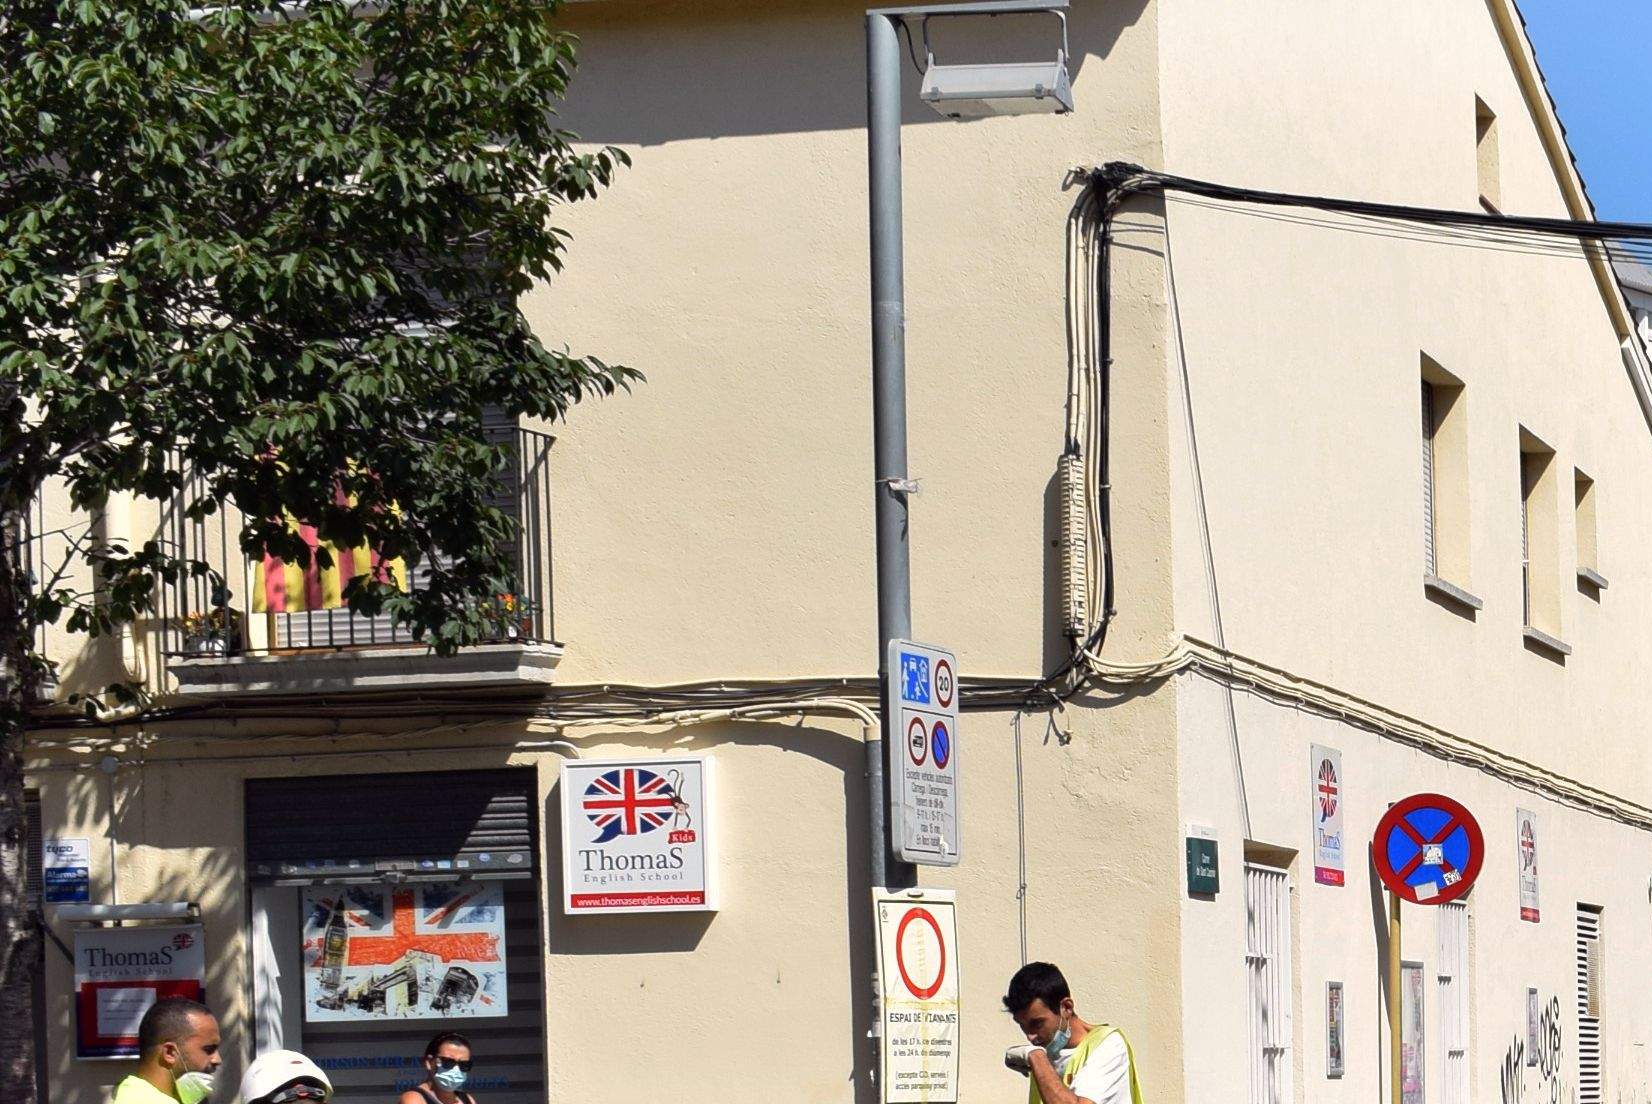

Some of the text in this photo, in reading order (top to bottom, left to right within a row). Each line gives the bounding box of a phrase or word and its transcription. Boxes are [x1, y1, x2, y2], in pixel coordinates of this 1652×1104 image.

[938, 675, 949, 692] 20
[672, 833, 693, 842] Kids
[578, 847, 684, 871] ThomaS
[583, 873, 684, 885] English School
[576, 895, 701, 907] www.thomasenglishschool.es
[84, 945, 173, 967] ThomaS
[889, 1013, 912, 1023] ESPAI
[913, 1013, 921, 1022] DE
